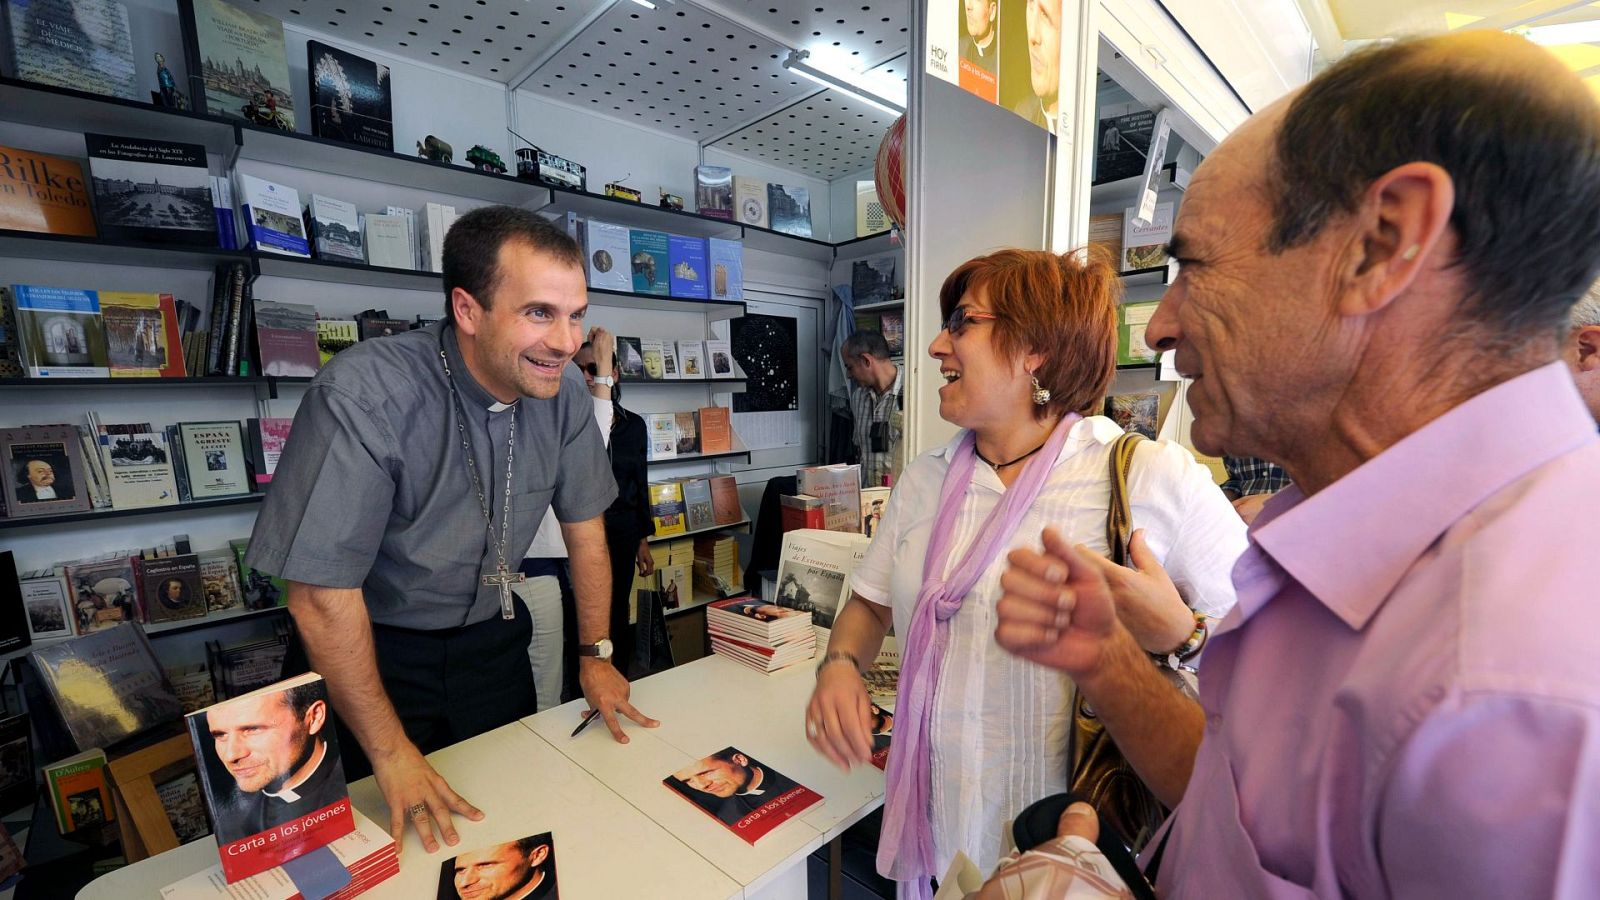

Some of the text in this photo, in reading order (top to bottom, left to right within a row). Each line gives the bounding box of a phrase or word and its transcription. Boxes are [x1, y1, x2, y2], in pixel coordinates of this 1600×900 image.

[931, 44, 948, 63] HOY
[930, 58, 948, 73] FIRMA
[21, 181, 87, 208] Toledo
[1133, 225, 1168, 233] Cervantes
[788, 541, 807, 553] Viajes
[801, 555, 840, 570] Extranjeros
[807, 567, 845, 582] por España
[737, 811, 761, 829] Carta
[765, 802, 780, 811] los
[779, 787, 806, 805] jóvenes
[227, 803, 347, 856] Carta a los jóvenes
